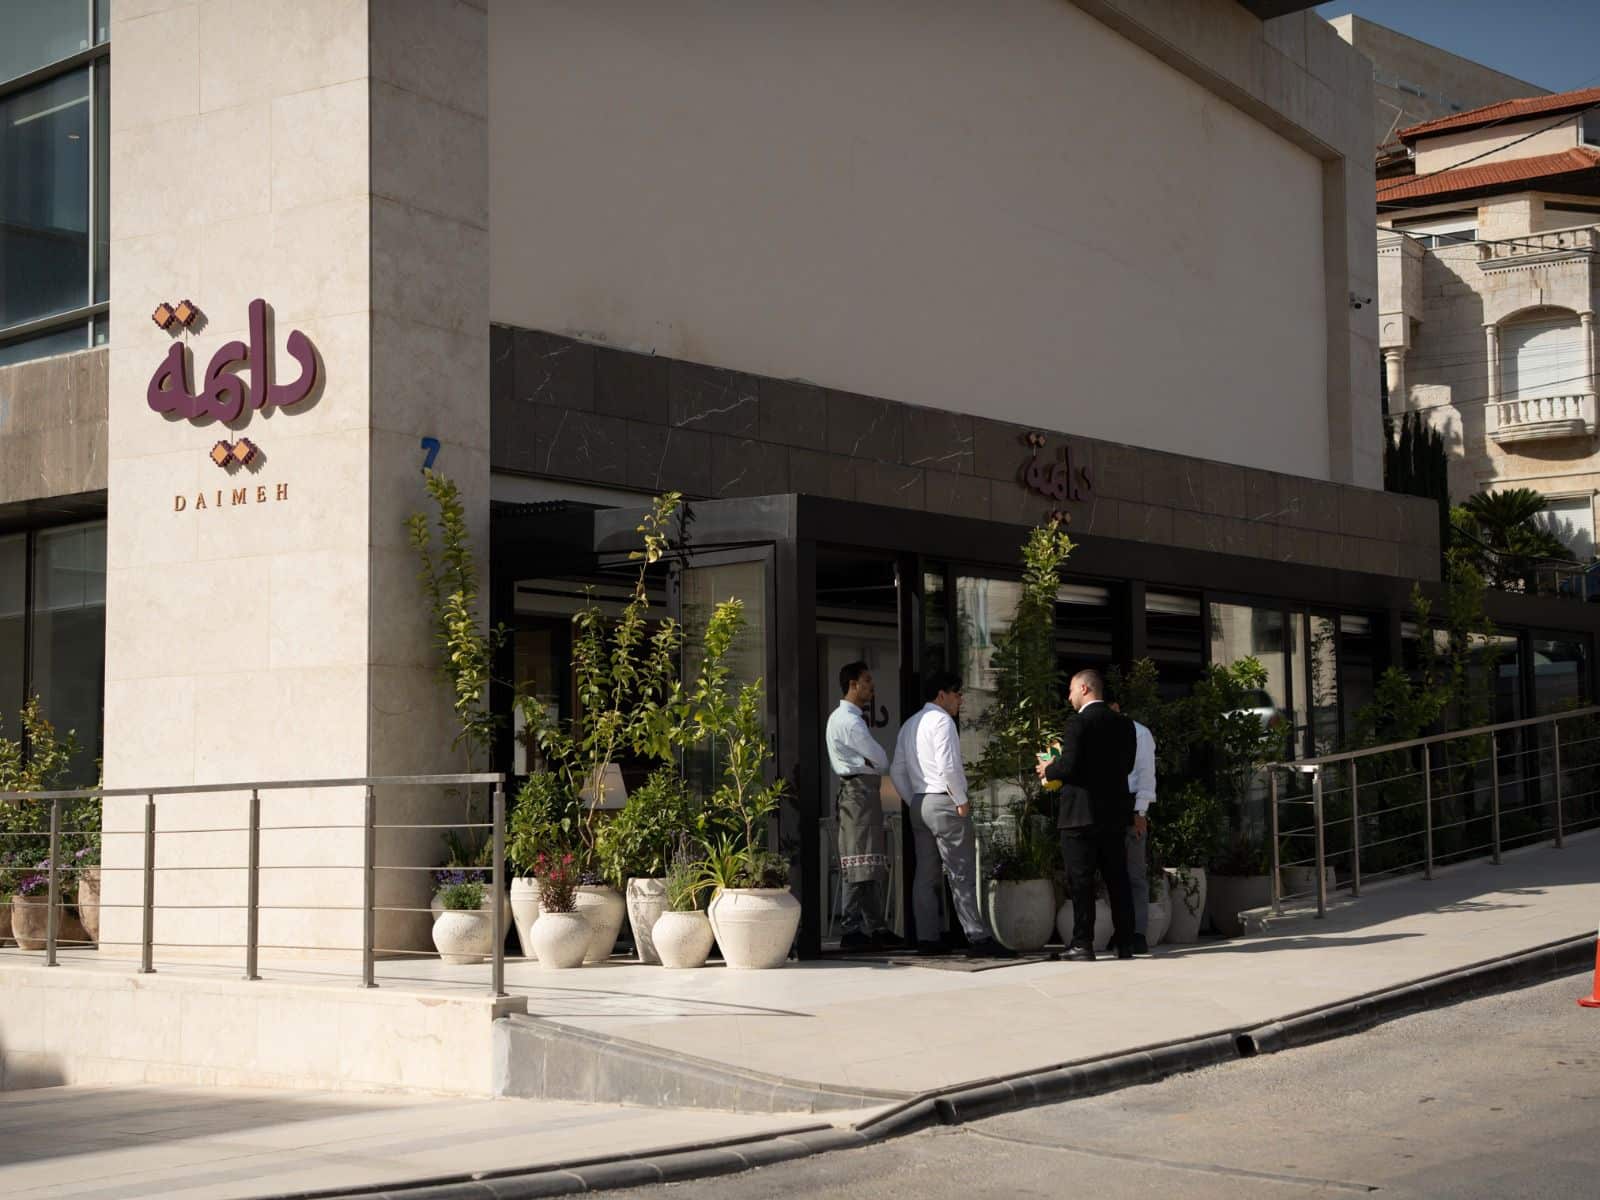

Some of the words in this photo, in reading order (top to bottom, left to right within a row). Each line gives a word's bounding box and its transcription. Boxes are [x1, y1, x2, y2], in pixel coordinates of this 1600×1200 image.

[147, 298, 317, 467] دايمة
[421, 437, 440, 474] 7
[174, 483, 288, 511] DAIMEH
